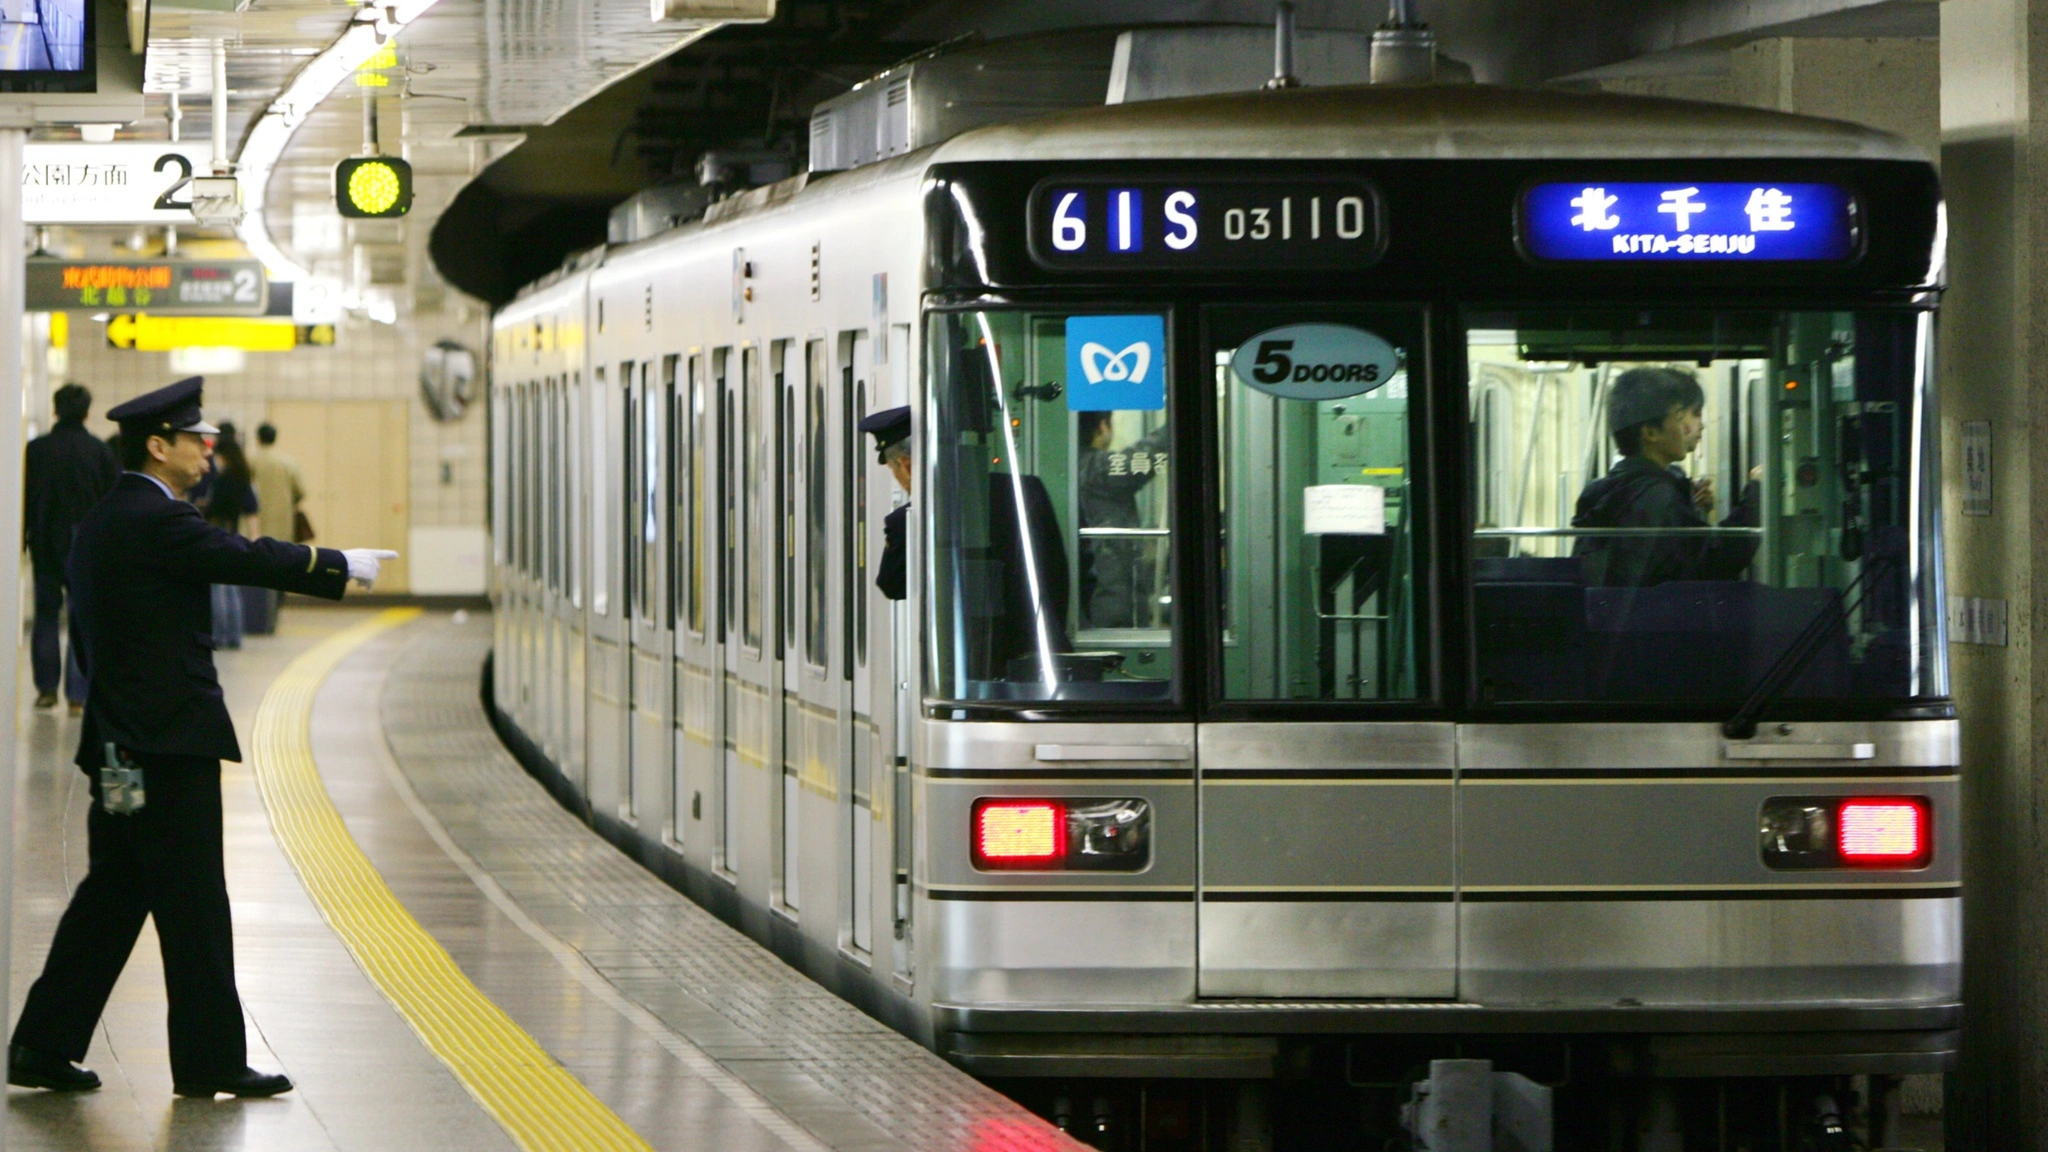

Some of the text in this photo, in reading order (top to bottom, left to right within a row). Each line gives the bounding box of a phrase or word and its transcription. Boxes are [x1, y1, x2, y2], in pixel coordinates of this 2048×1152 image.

[153, 152, 193, 210] 2
[1224, 195, 1364, 241] 03110
[1570, 187, 1796, 232] 北千住
[1612, 234, 1756, 254] KITA-SENJU
[233, 268, 258, 302] 2
[1251, 339, 1380, 384] 5 DOORS
